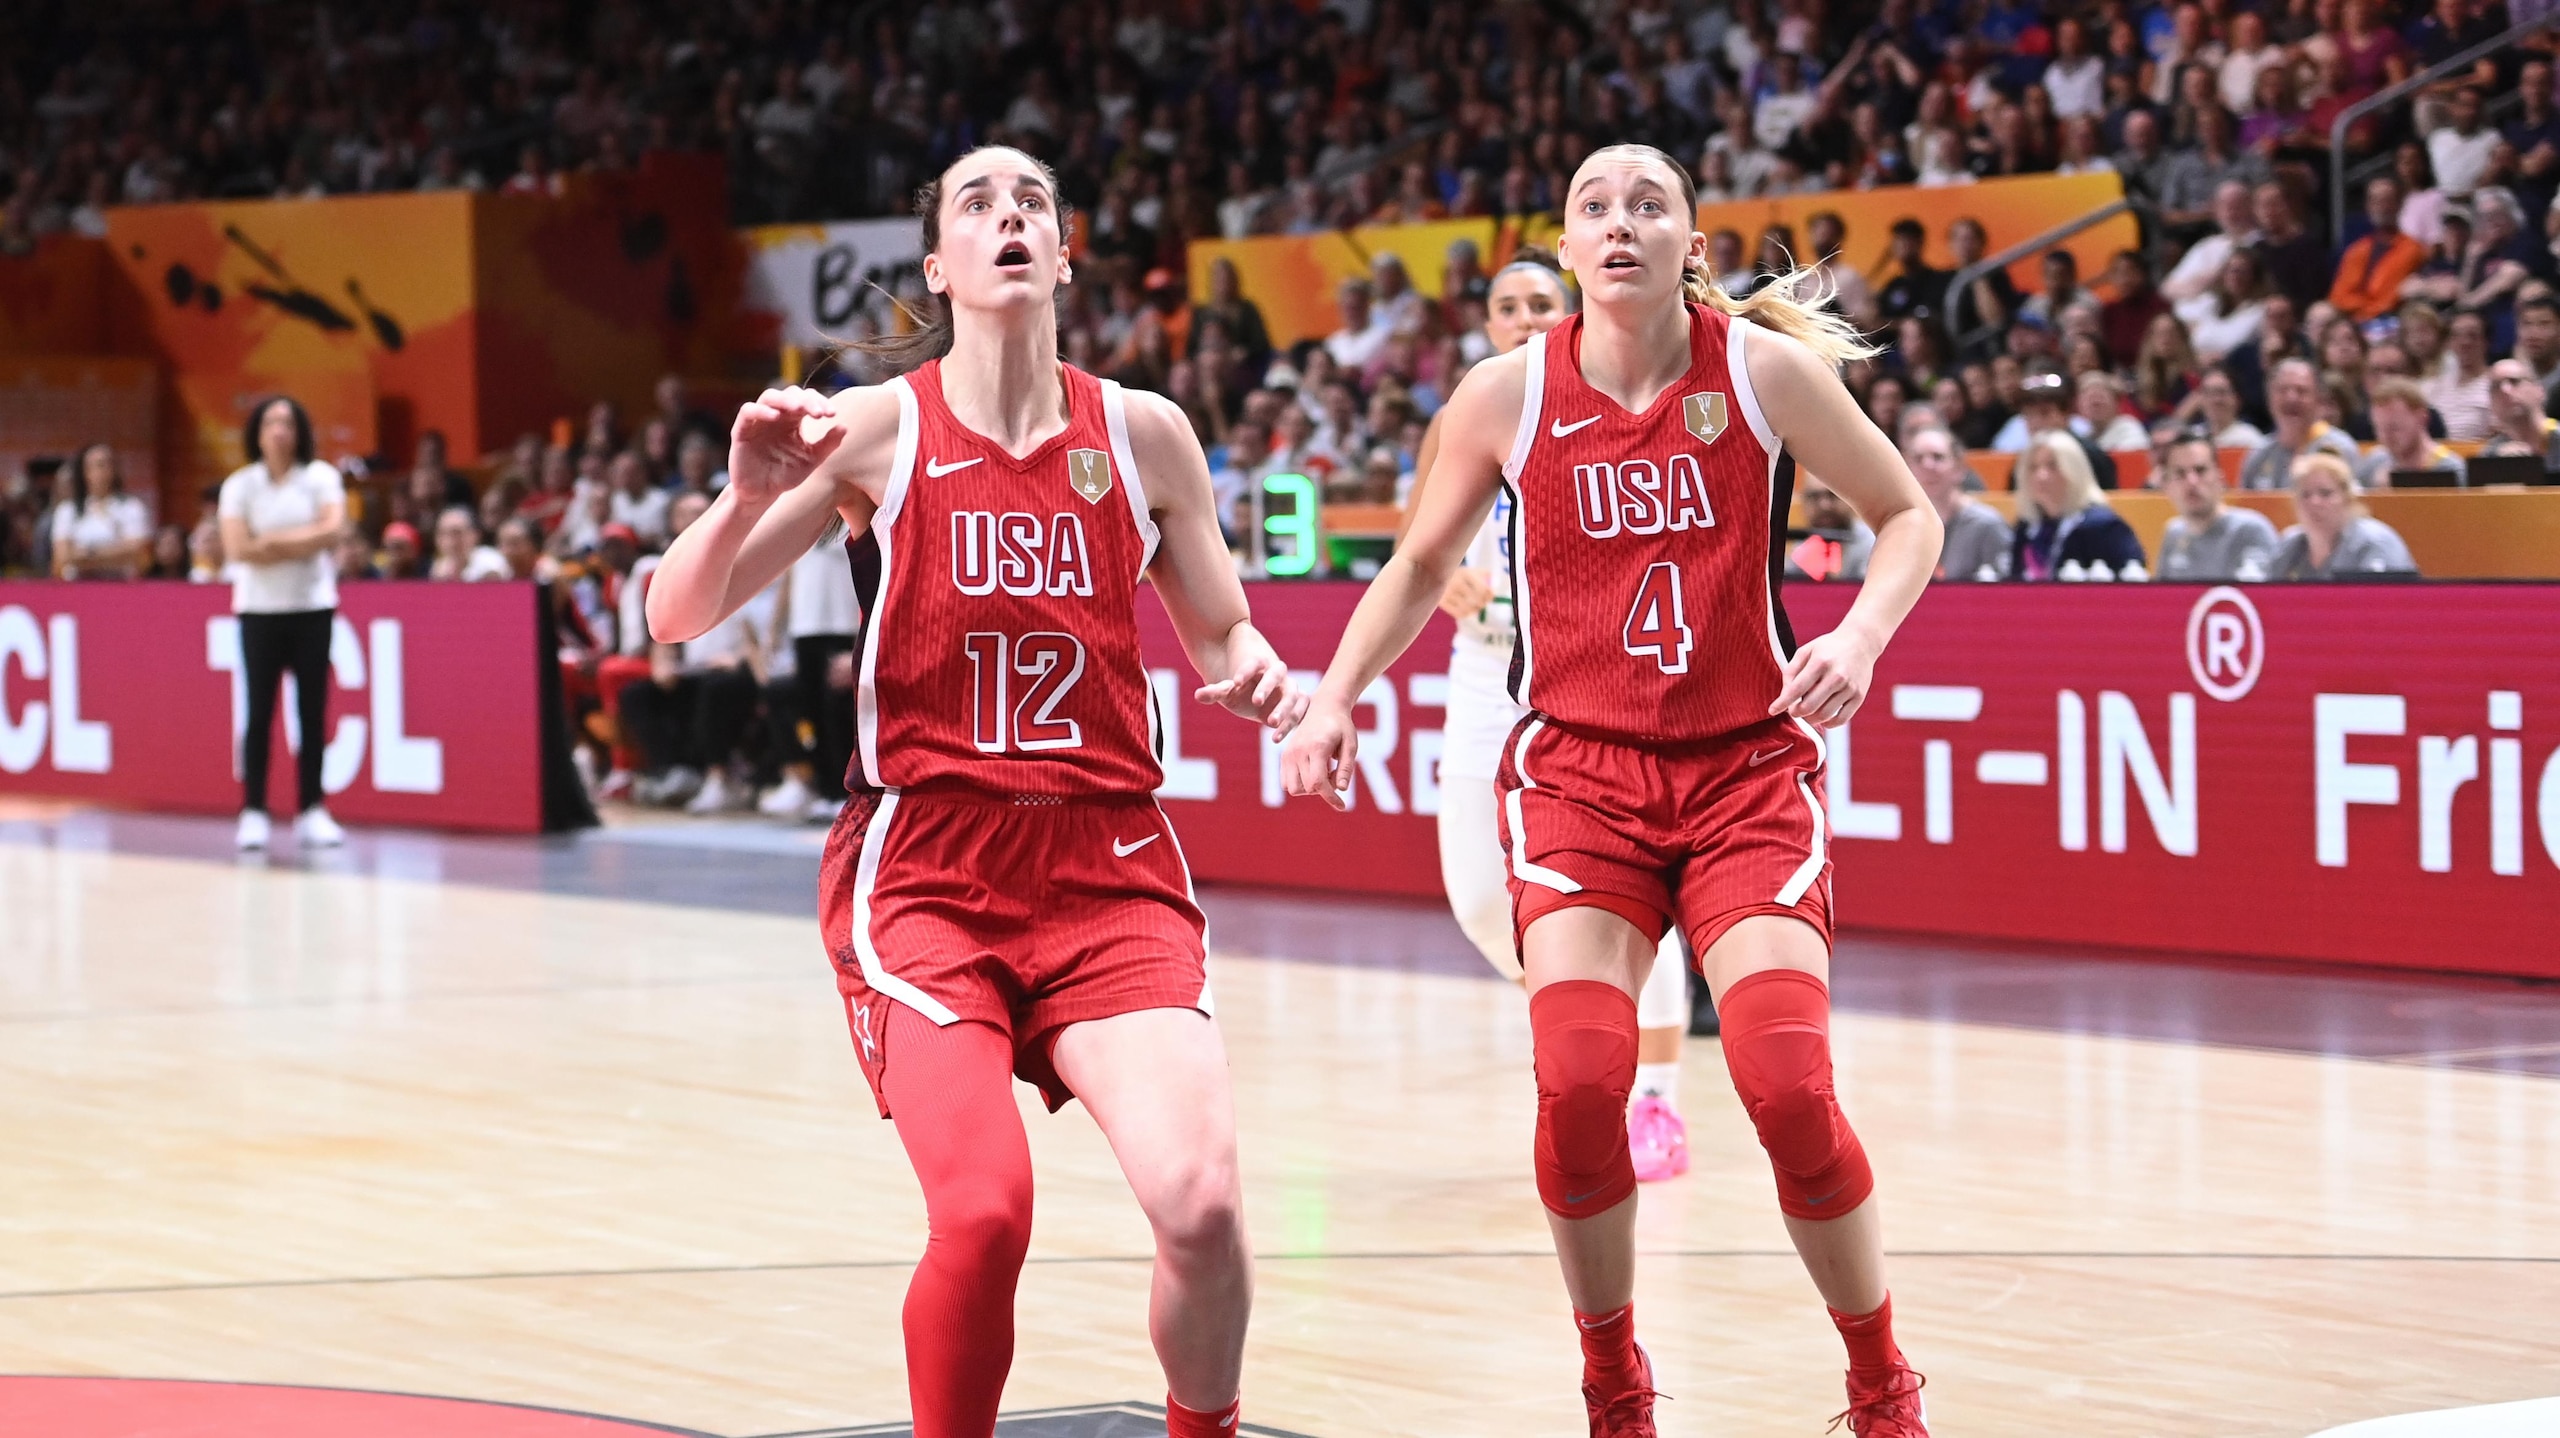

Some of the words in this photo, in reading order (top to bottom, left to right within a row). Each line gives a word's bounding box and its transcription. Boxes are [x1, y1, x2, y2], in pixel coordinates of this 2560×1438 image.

[1263, 473, 1316, 576] 3
[1574, 454, 1716, 539] USA
[951, 511, 1094, 597] USA
[1623, 561, 1694, 675] 4
[965, 632, 1085, 752] 12
